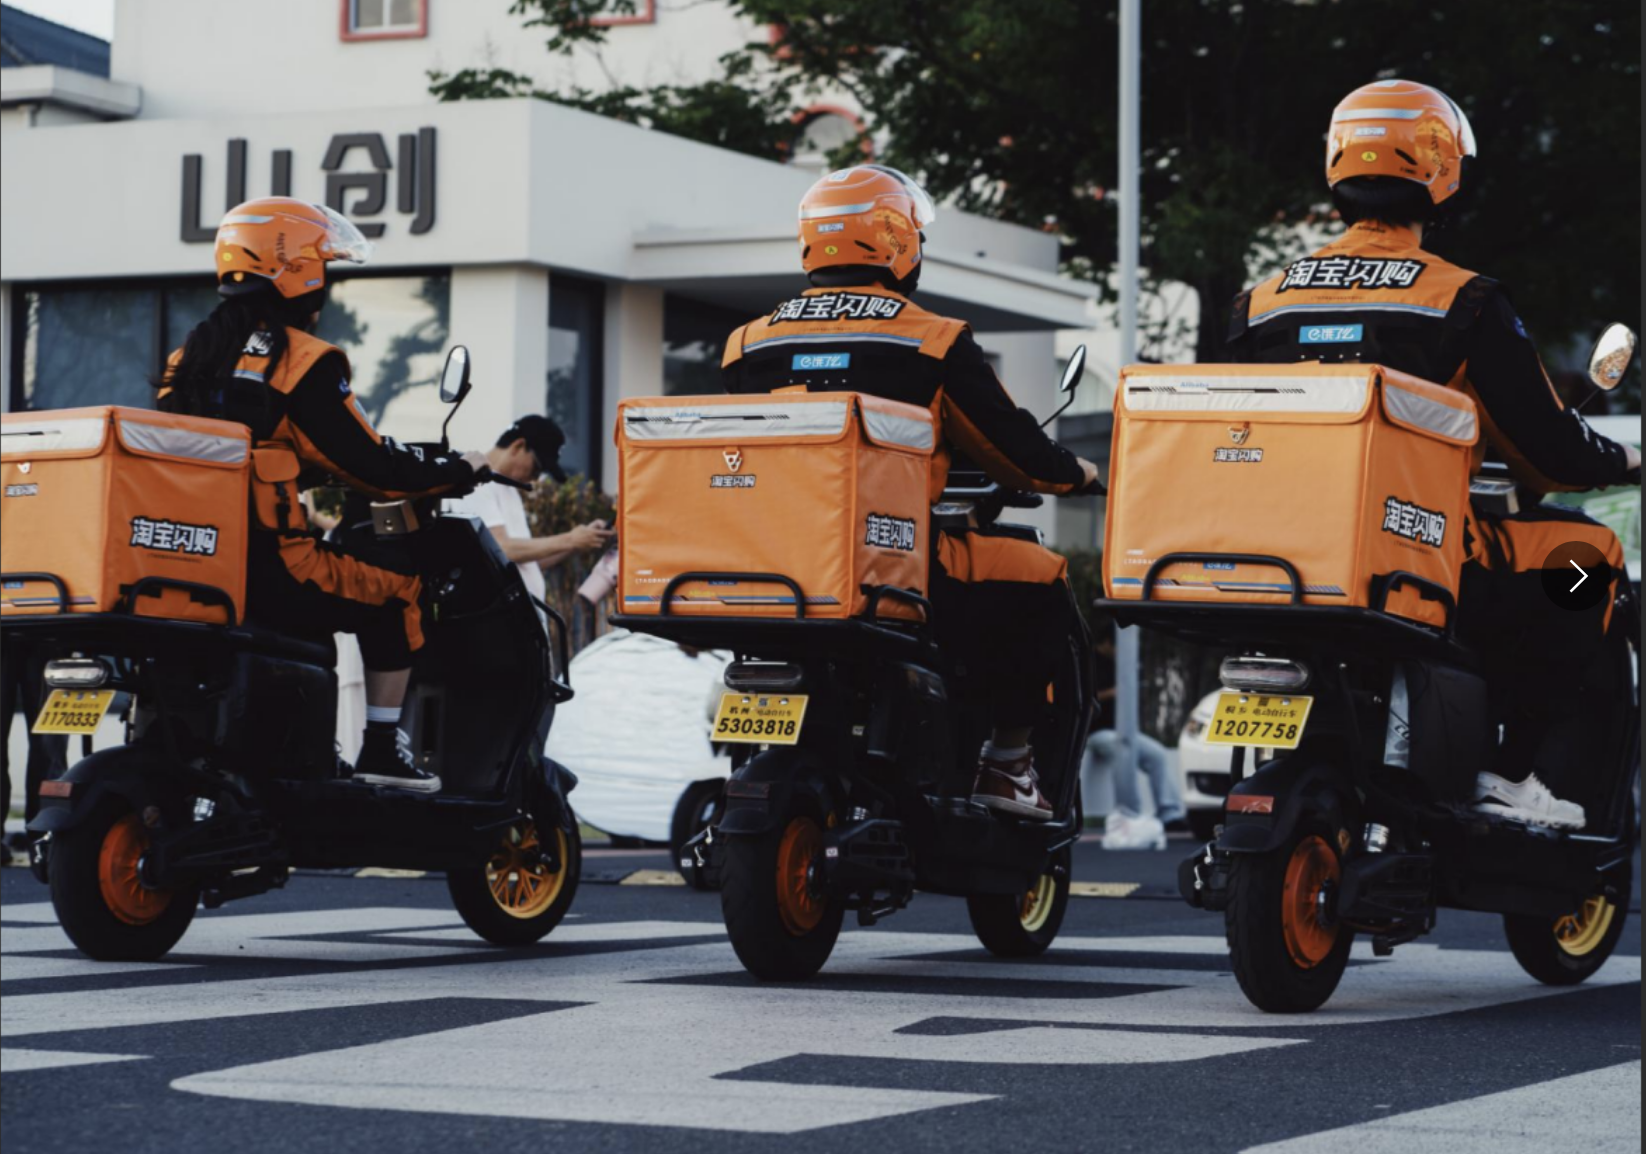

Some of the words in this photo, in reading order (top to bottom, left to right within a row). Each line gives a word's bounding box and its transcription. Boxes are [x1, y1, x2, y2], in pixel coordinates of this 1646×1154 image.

[1280, 257, 1421, 290] 淘宝闪购
[772, 293, 902, 322] 淘宝闪购
[131, 518, 218, 555] 淘宝闪购
[866, 514, 915, 549] 淘宝闪购
[1383, 498, 1446, 547] 淘宝闪购
[41, 711, 101, 727] 1170333
[717, 717, 796, 736] 5303818
[1214, 719, 1298, 740] 1207758
